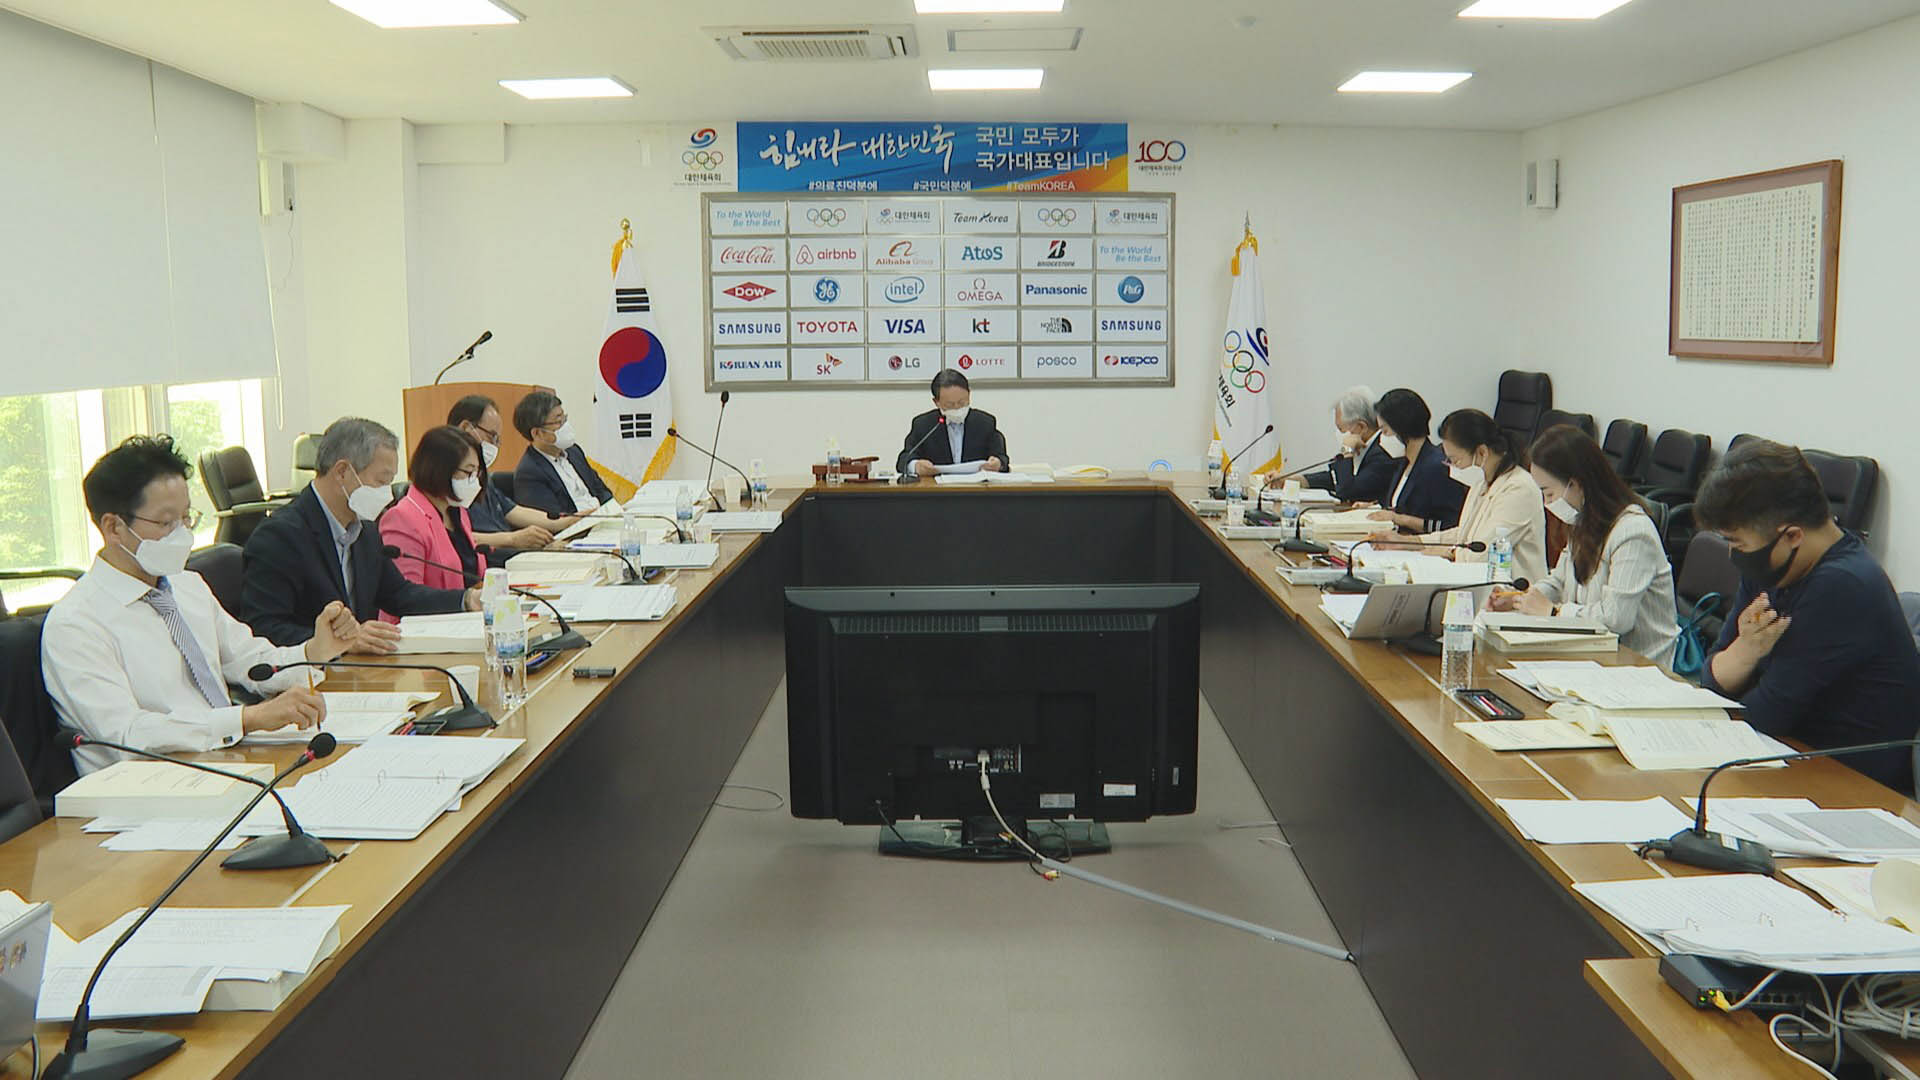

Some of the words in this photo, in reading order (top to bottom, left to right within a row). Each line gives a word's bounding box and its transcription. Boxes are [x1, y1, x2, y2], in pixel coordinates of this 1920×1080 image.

[976, 126, 1013, 146] 국민
[1021, 126, 1079, 147] 모두가
[759, 128, 856, 170] 힘내라
[861, 123, 956, 175] 대한민국
[1134, 139, 1186, 163] 100
[975, 151, 1110, 172] 국가대표입니다
[1007, 180, 1076, 192] #TeamKOREA
[716, 210, 726, 218] To
[728, 210, 741, 218] the
[745, 209, 771, 218] World
[953, 212, 977, 223] Team
[733, 219, 744, 227] Be
[746, 219, 760, 227] the
[762, 218, 781, 227] Best
[817, 248, 857, 261] airbnb
[1100, 246, 1109, 254] To
[1111, 246, 1124, 254] the
[1127, 245, 1152, 254] World
[1115, 255, 1127, 263] Be
[1128, 255, 1142, 263] the
[1143, 254, 1161, 263] Best
[890, 281, 918, 296] intel
[1025, 284, 1088, 296] Panasonic
[957, 291, 1003, 301] OMEGA
[719, 323, 781, 335] SAMSUNG
[797, 321, 858, 333] TOYOTA
[884, 319, 926, 334] VISA
[972, 318, 990, 334] kt
[1101, 320, 1162, 331] SAMSUNG
[720, 361, 760, 370] KOREAN
[762, 360, 782, 369] AIR
[905, 358, 920, 368] LG
[976, 358, 1005, 366] LOTTE
[816, 365, 831, 376] SK
